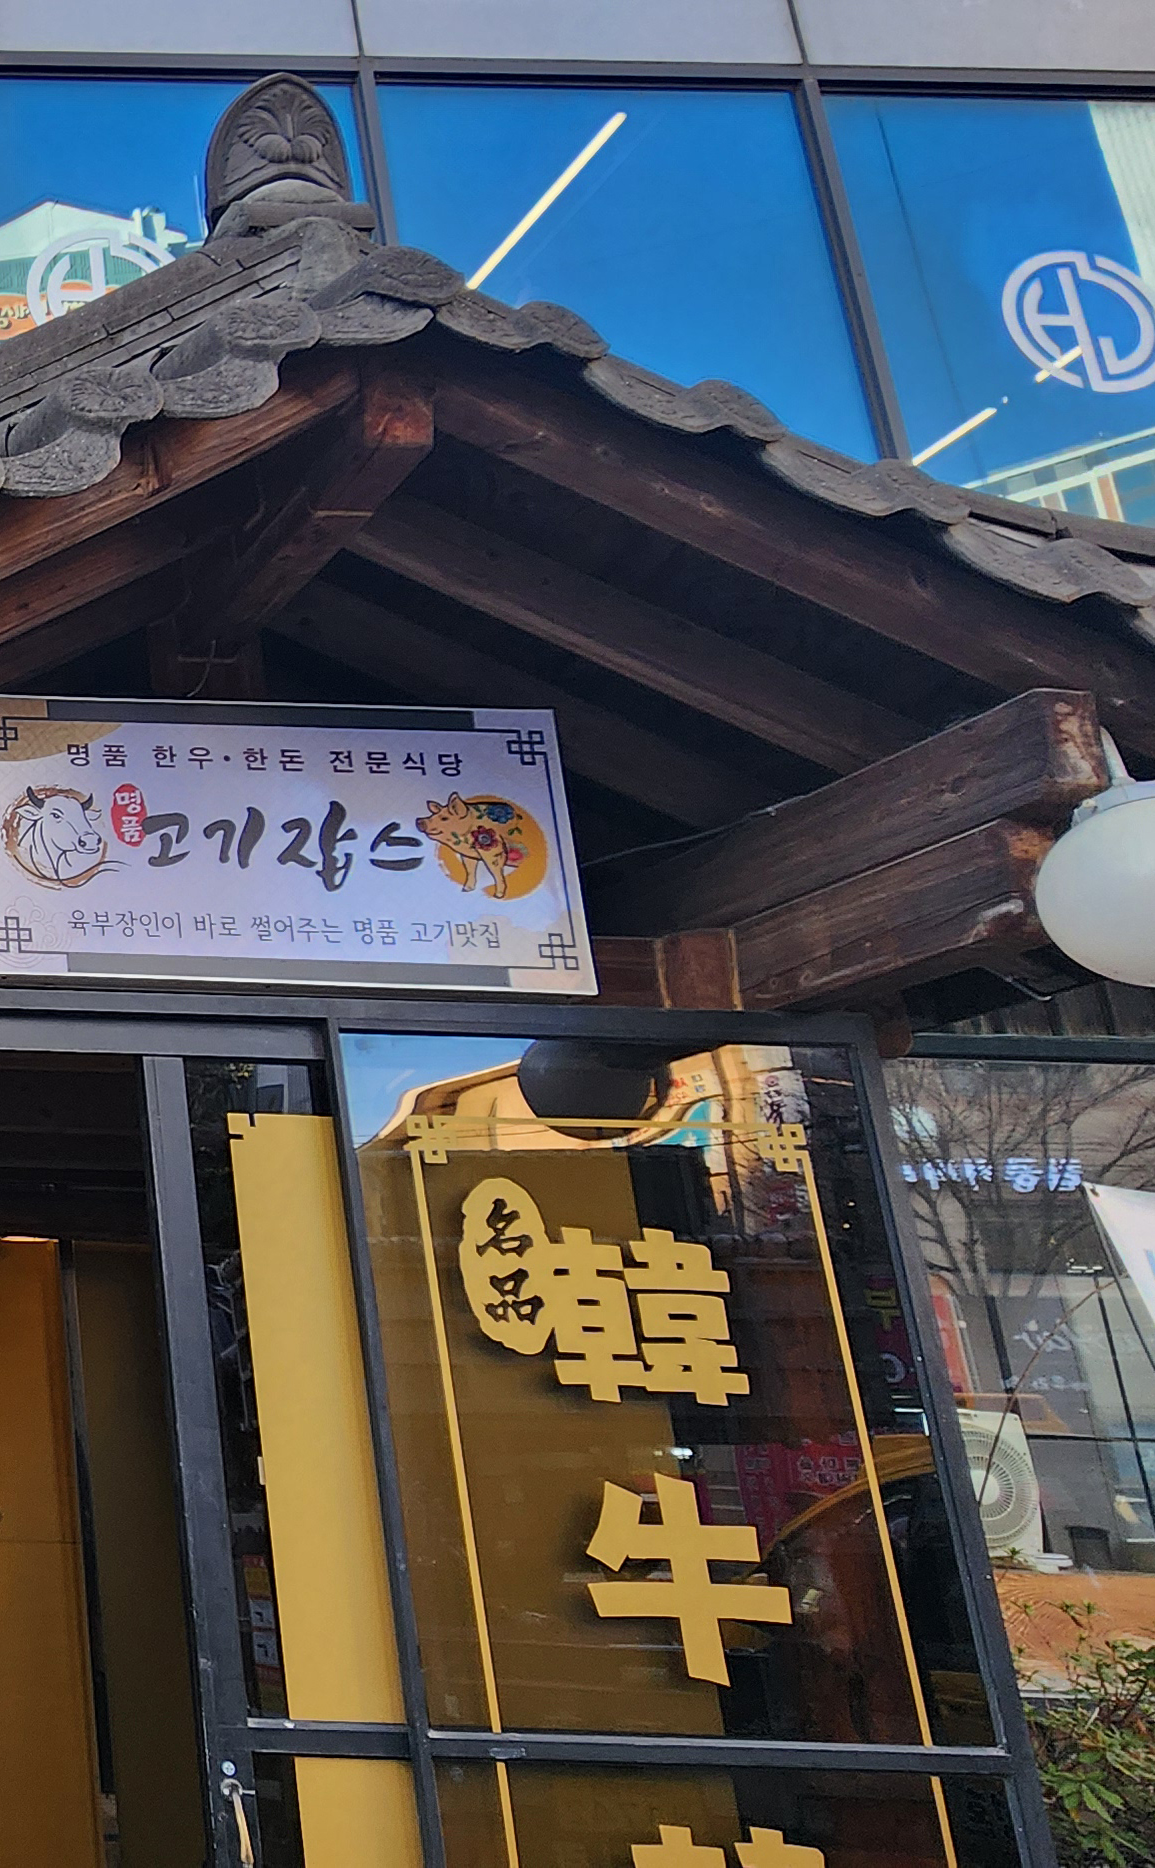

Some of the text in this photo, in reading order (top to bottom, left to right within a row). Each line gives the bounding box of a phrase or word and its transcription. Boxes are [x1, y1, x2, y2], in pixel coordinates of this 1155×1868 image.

[67, 743, 128, 768] 명품
[329, 750, 463, 777] 전문식당
[115, 789, 143, 843] 명품
[142, 800, 425, 892] 고기잡스
[68, 910, 501, 949] 육부장인이 바로 썰어주는 명품 고기맛집
[476, 1198, 546, 1325] 名品
